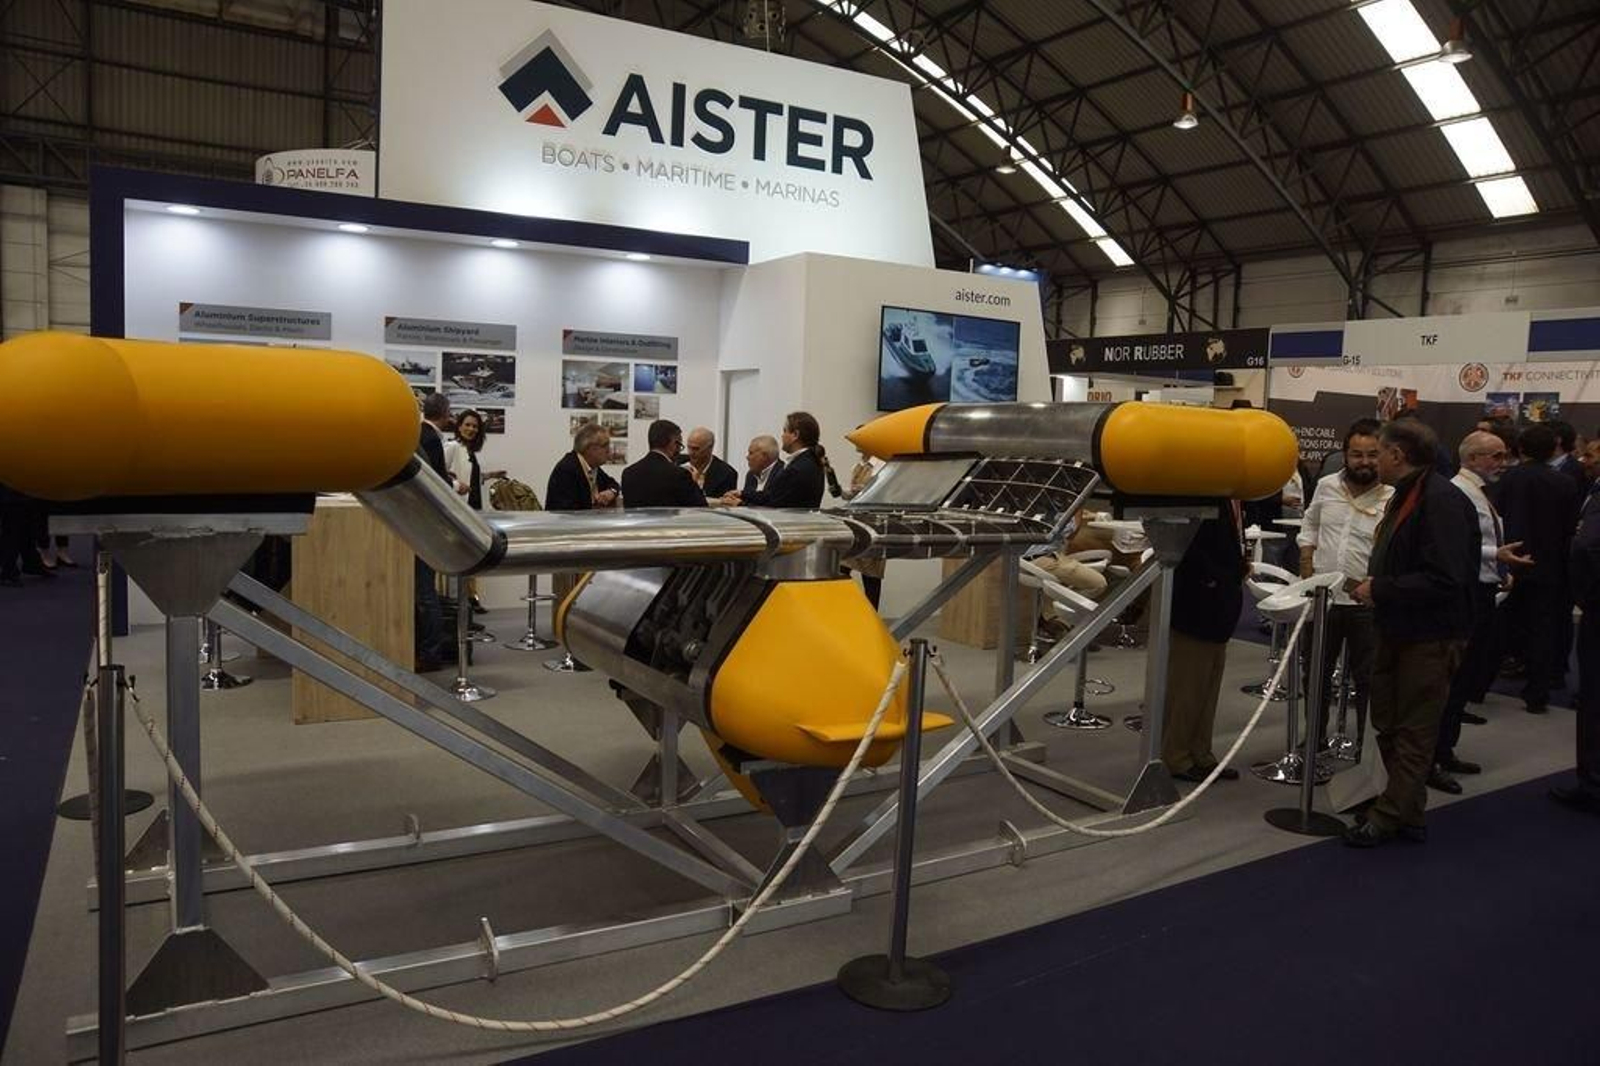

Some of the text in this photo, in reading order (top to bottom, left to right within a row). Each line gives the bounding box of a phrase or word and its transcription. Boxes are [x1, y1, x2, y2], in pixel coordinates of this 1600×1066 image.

[602, 73, 874, 181] AISTER
[286, 167, 359, 180] PANELFA
[541, 142, 841, 208] BOATS MARITIME MARINAS
[954, 288, 1011, 307] aister.com
[194, 310, 321, 326] Aluminium Superstructures
[1420, 334, 1438, 346] TKF
[1104, 344, 1185, 362] NOR RUBBER
[1343, 354, 1361, 366] G-15
[1246, 357, 1265, 367] G16
[1502, 371, 1523, 381] TKF
